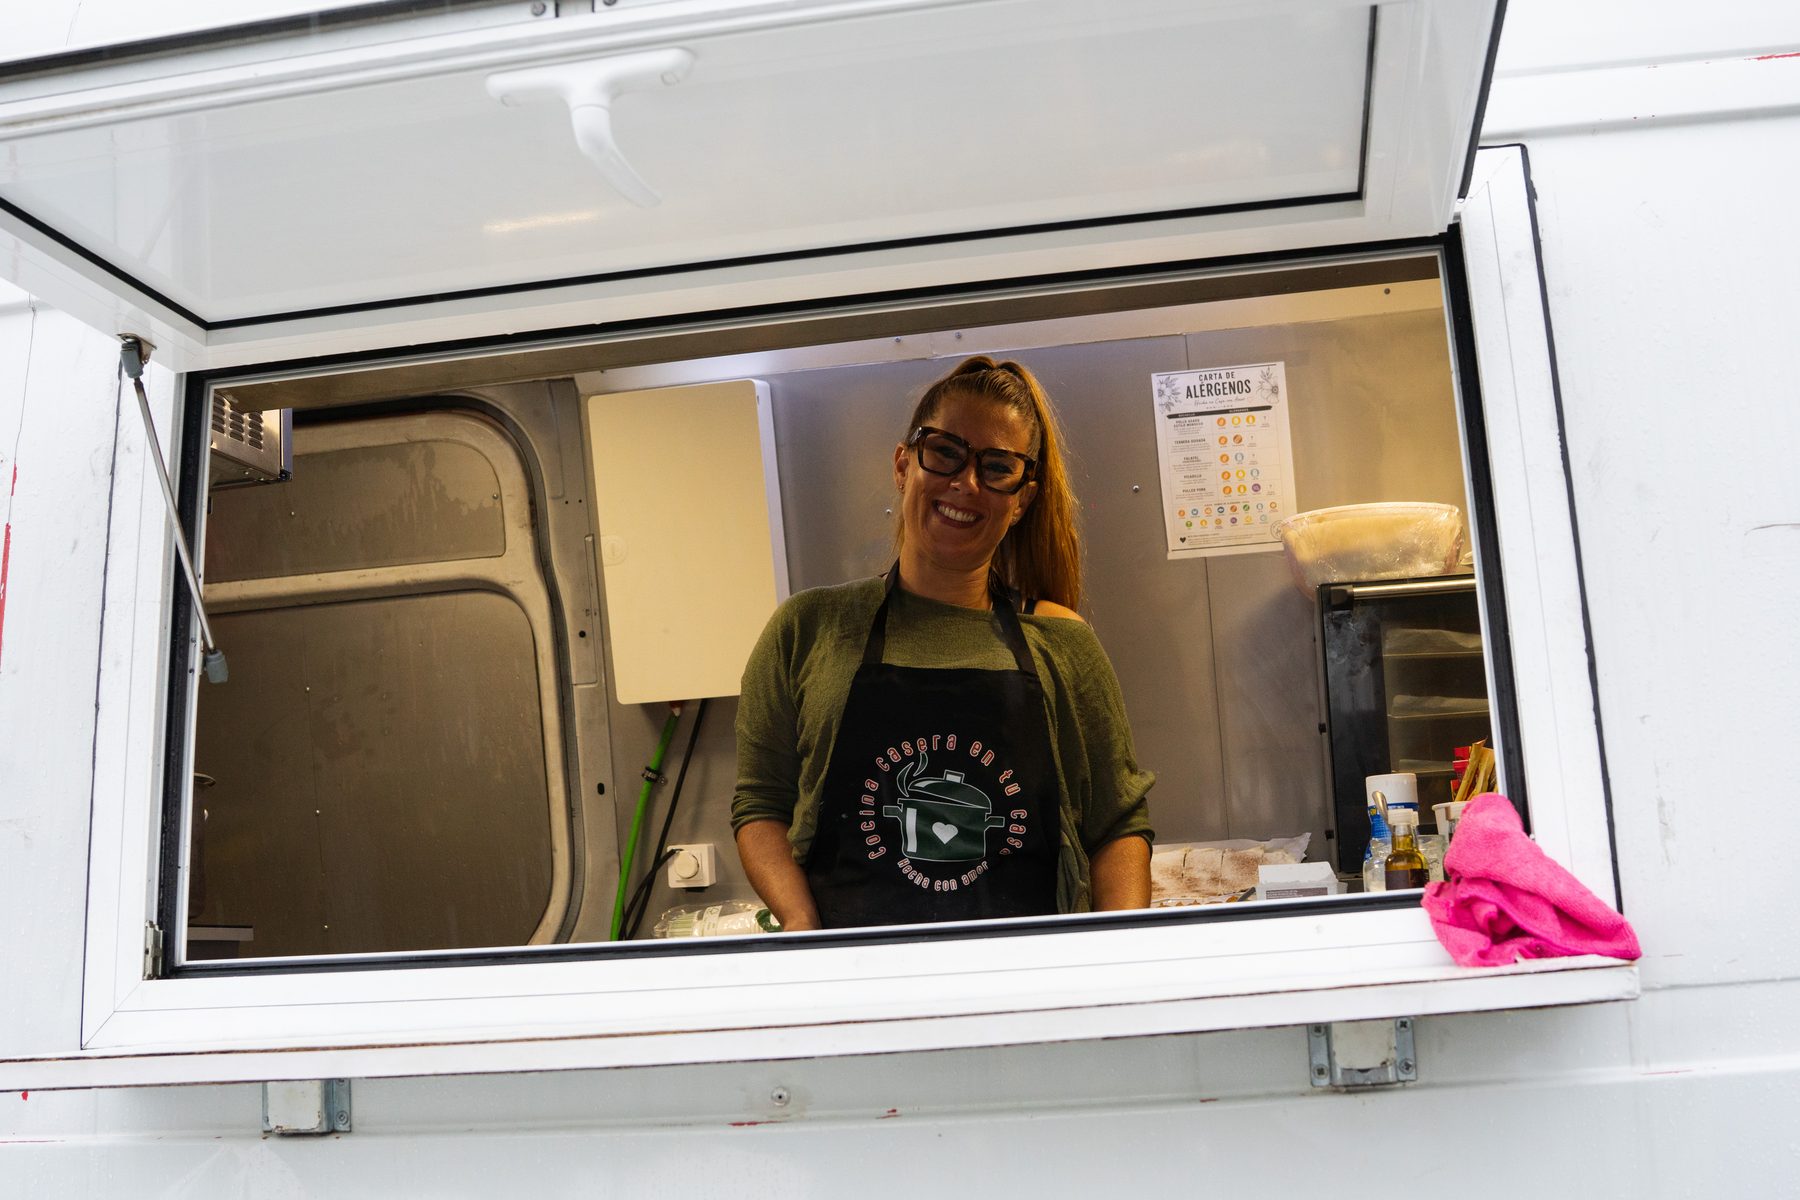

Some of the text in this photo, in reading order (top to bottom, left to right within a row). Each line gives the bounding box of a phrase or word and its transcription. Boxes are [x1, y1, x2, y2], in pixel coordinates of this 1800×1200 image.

[1186, 379, 1252, 399] ALÉRGENOS
[1198, 371, 1236, 382] CARTA DE
[969, 741, 995, 767] en
[998, 769, 1022, 797] tu
[934, 878, 958, 892] con
[961, 860, 990, 886] amor
